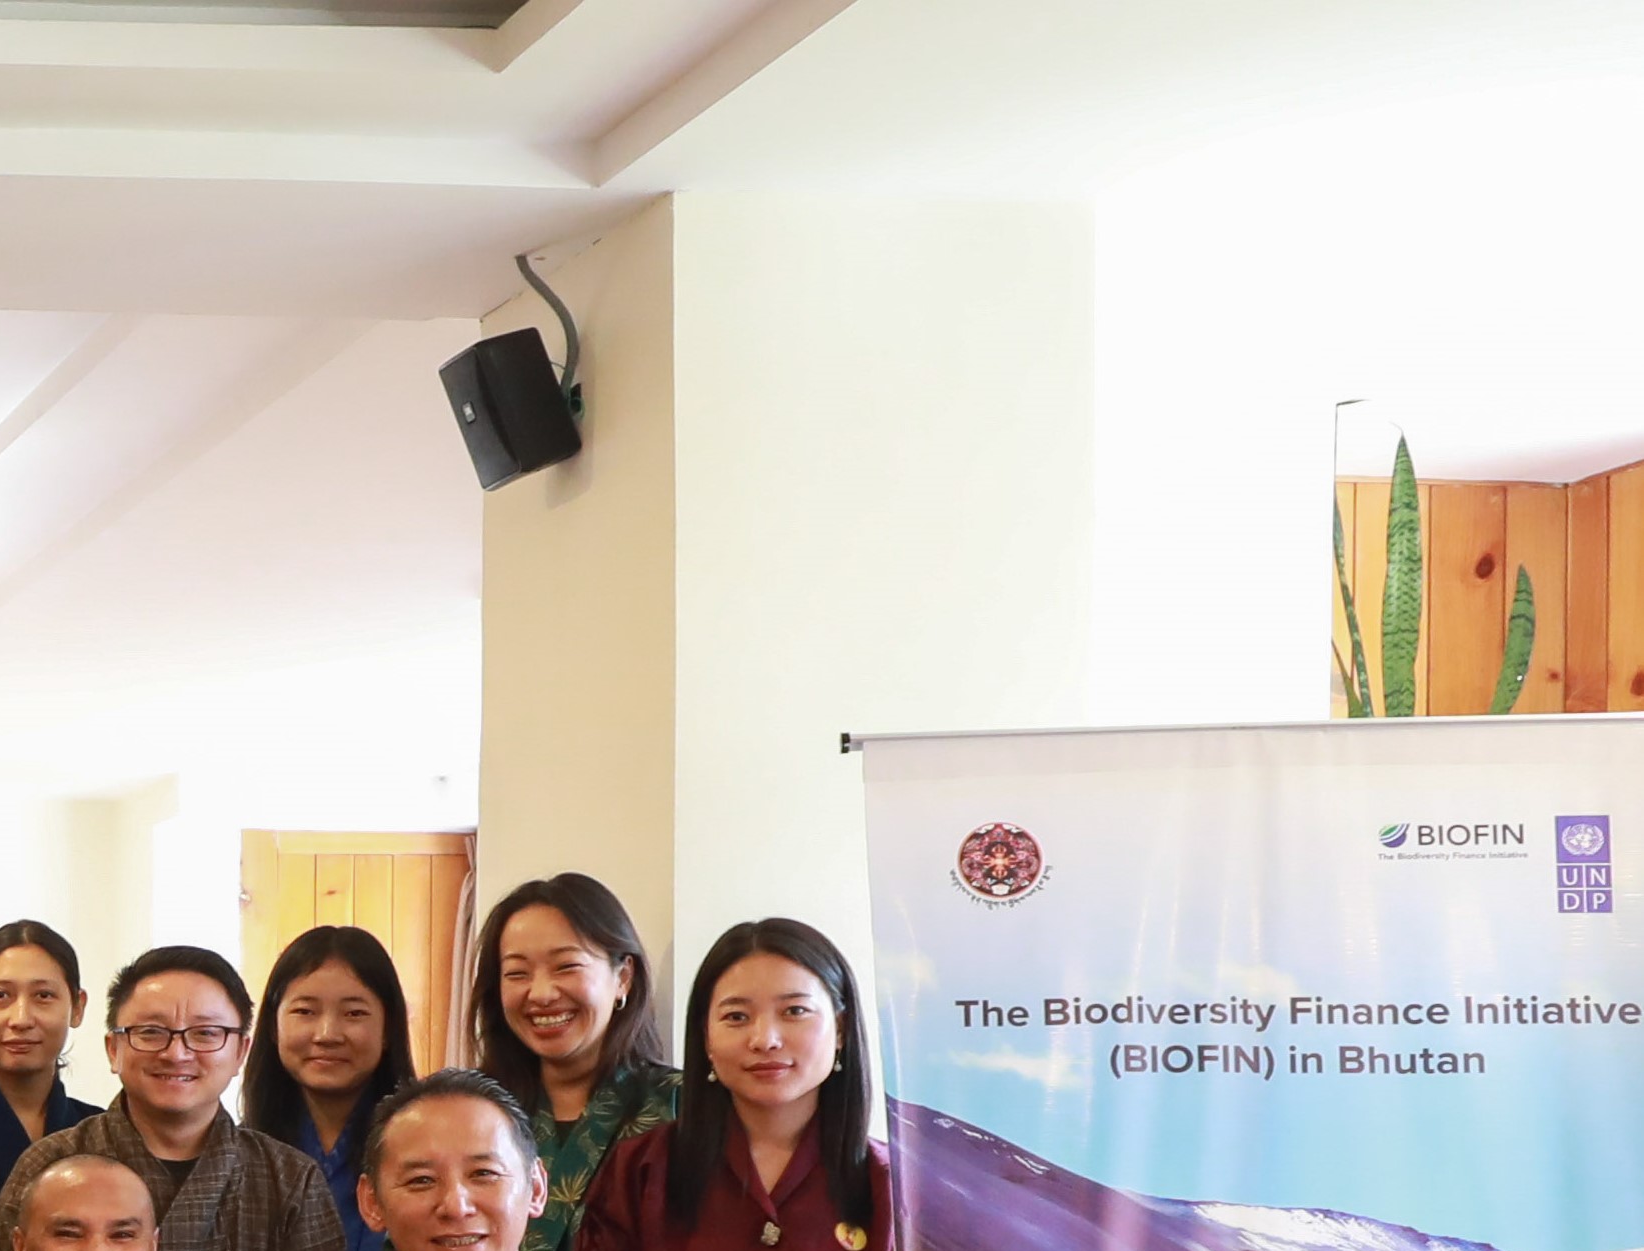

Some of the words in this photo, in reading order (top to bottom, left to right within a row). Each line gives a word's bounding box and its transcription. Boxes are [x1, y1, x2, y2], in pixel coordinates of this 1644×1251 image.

[1417, 823, 1524, 846] BIOFIN
[1378, 853, 1394, 861] The
[1397, 852, 1450, 862] Biodiversity
[1452, 852, 1486, 860] Finance
[1489, 851, 1529, 859] Initiative
[955, 1000, 1030, 1027] The
[1043, 995, 1276, 1033] Biodiversity
[1289, 996, 1450, 1025] Finance
[1464, 995, 1643, 1026] Initiative
[1110, 1045, 1275, 1081] (BIOFIN)
[1289, 1045, 1323, 1074] in
[1339, 1045, 1486, 1075] Bhutan
